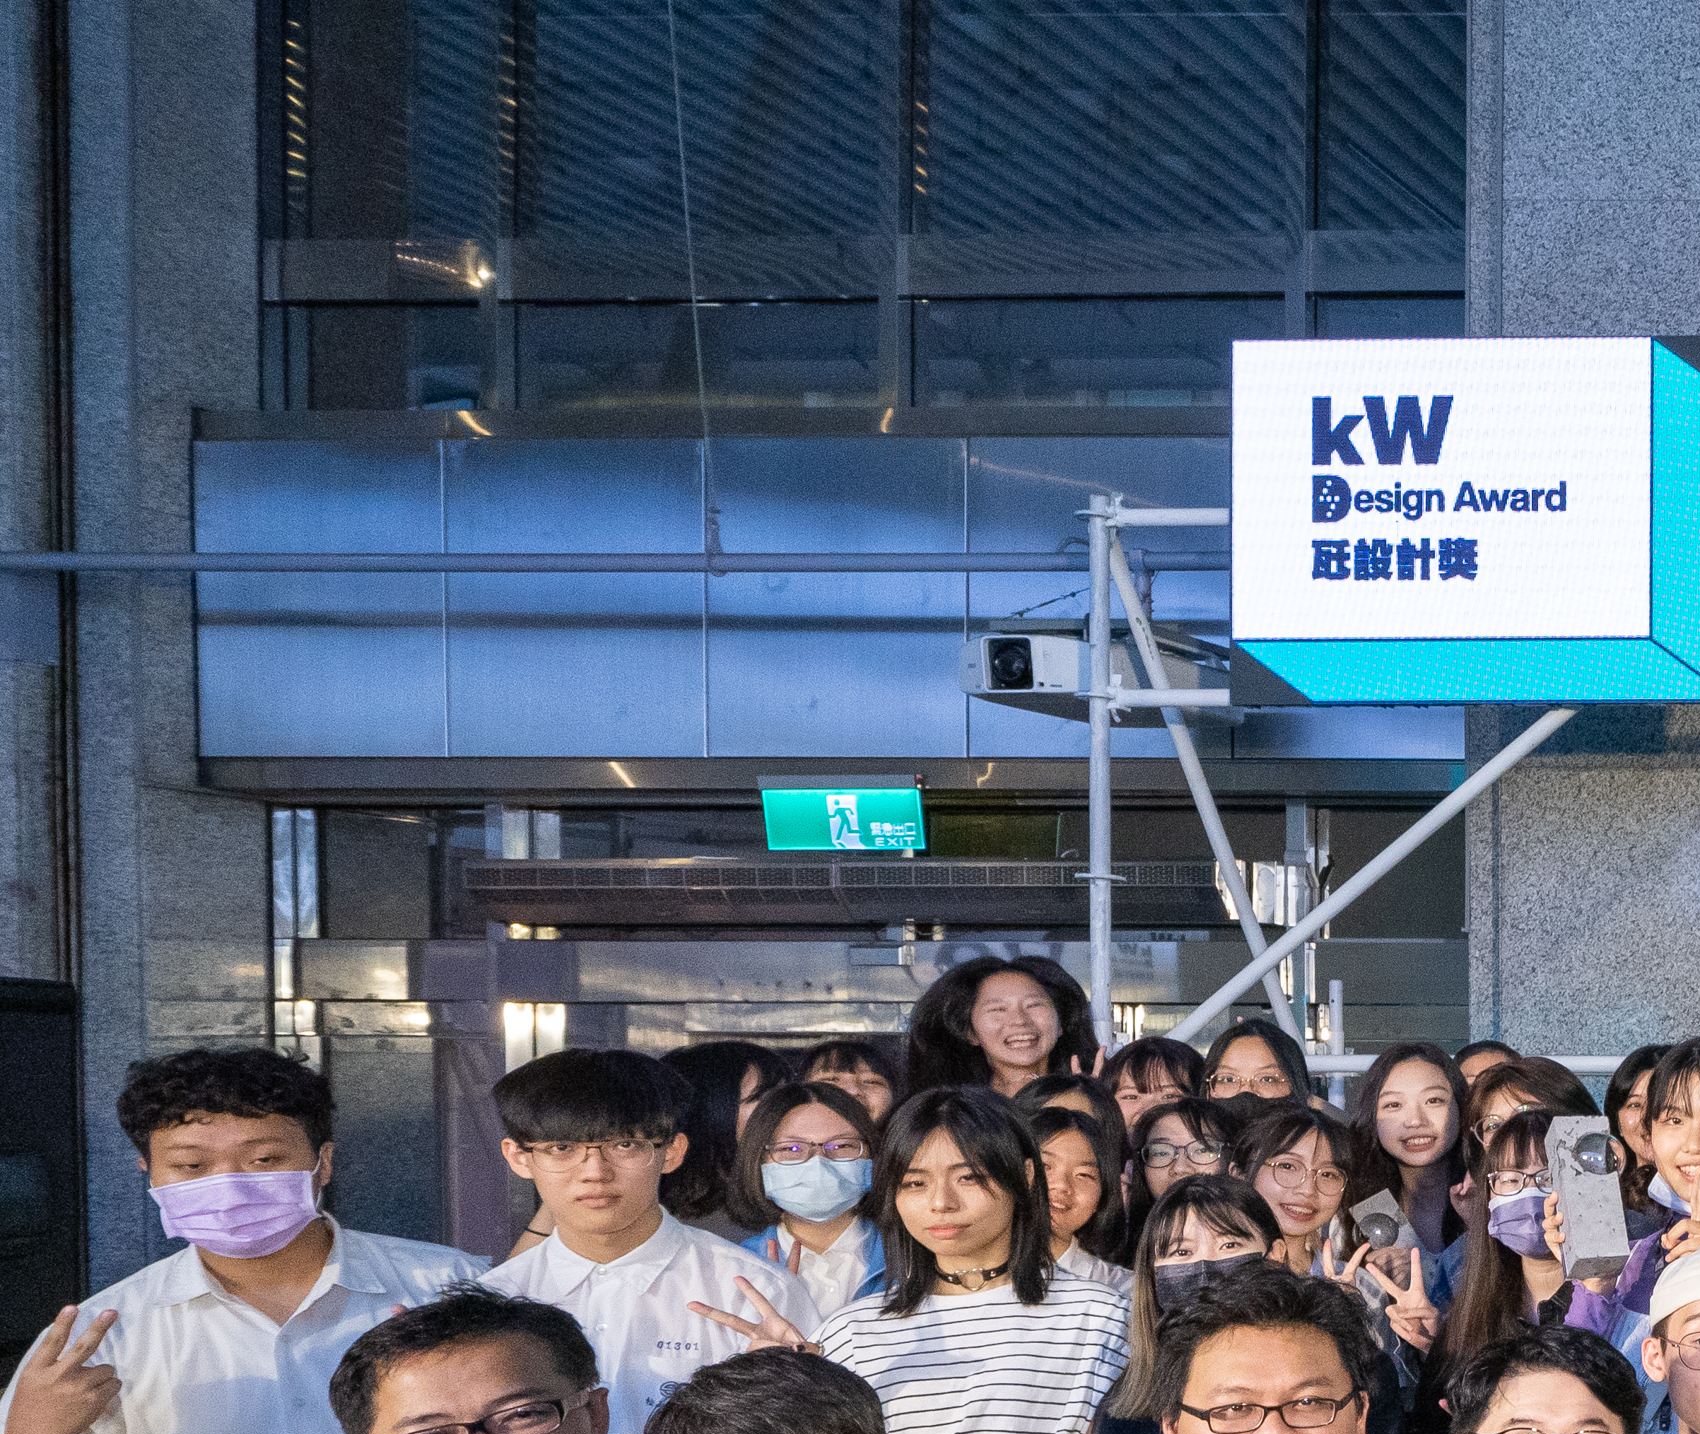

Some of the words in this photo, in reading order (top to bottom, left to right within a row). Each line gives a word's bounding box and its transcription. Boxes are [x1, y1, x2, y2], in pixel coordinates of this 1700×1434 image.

[1312, 395, 1454, 465] kW
[1312, 475, 1446, 523] Design
[1453, 481, 1567, 512] Award
[875, 837, 916, 846] EXIT
